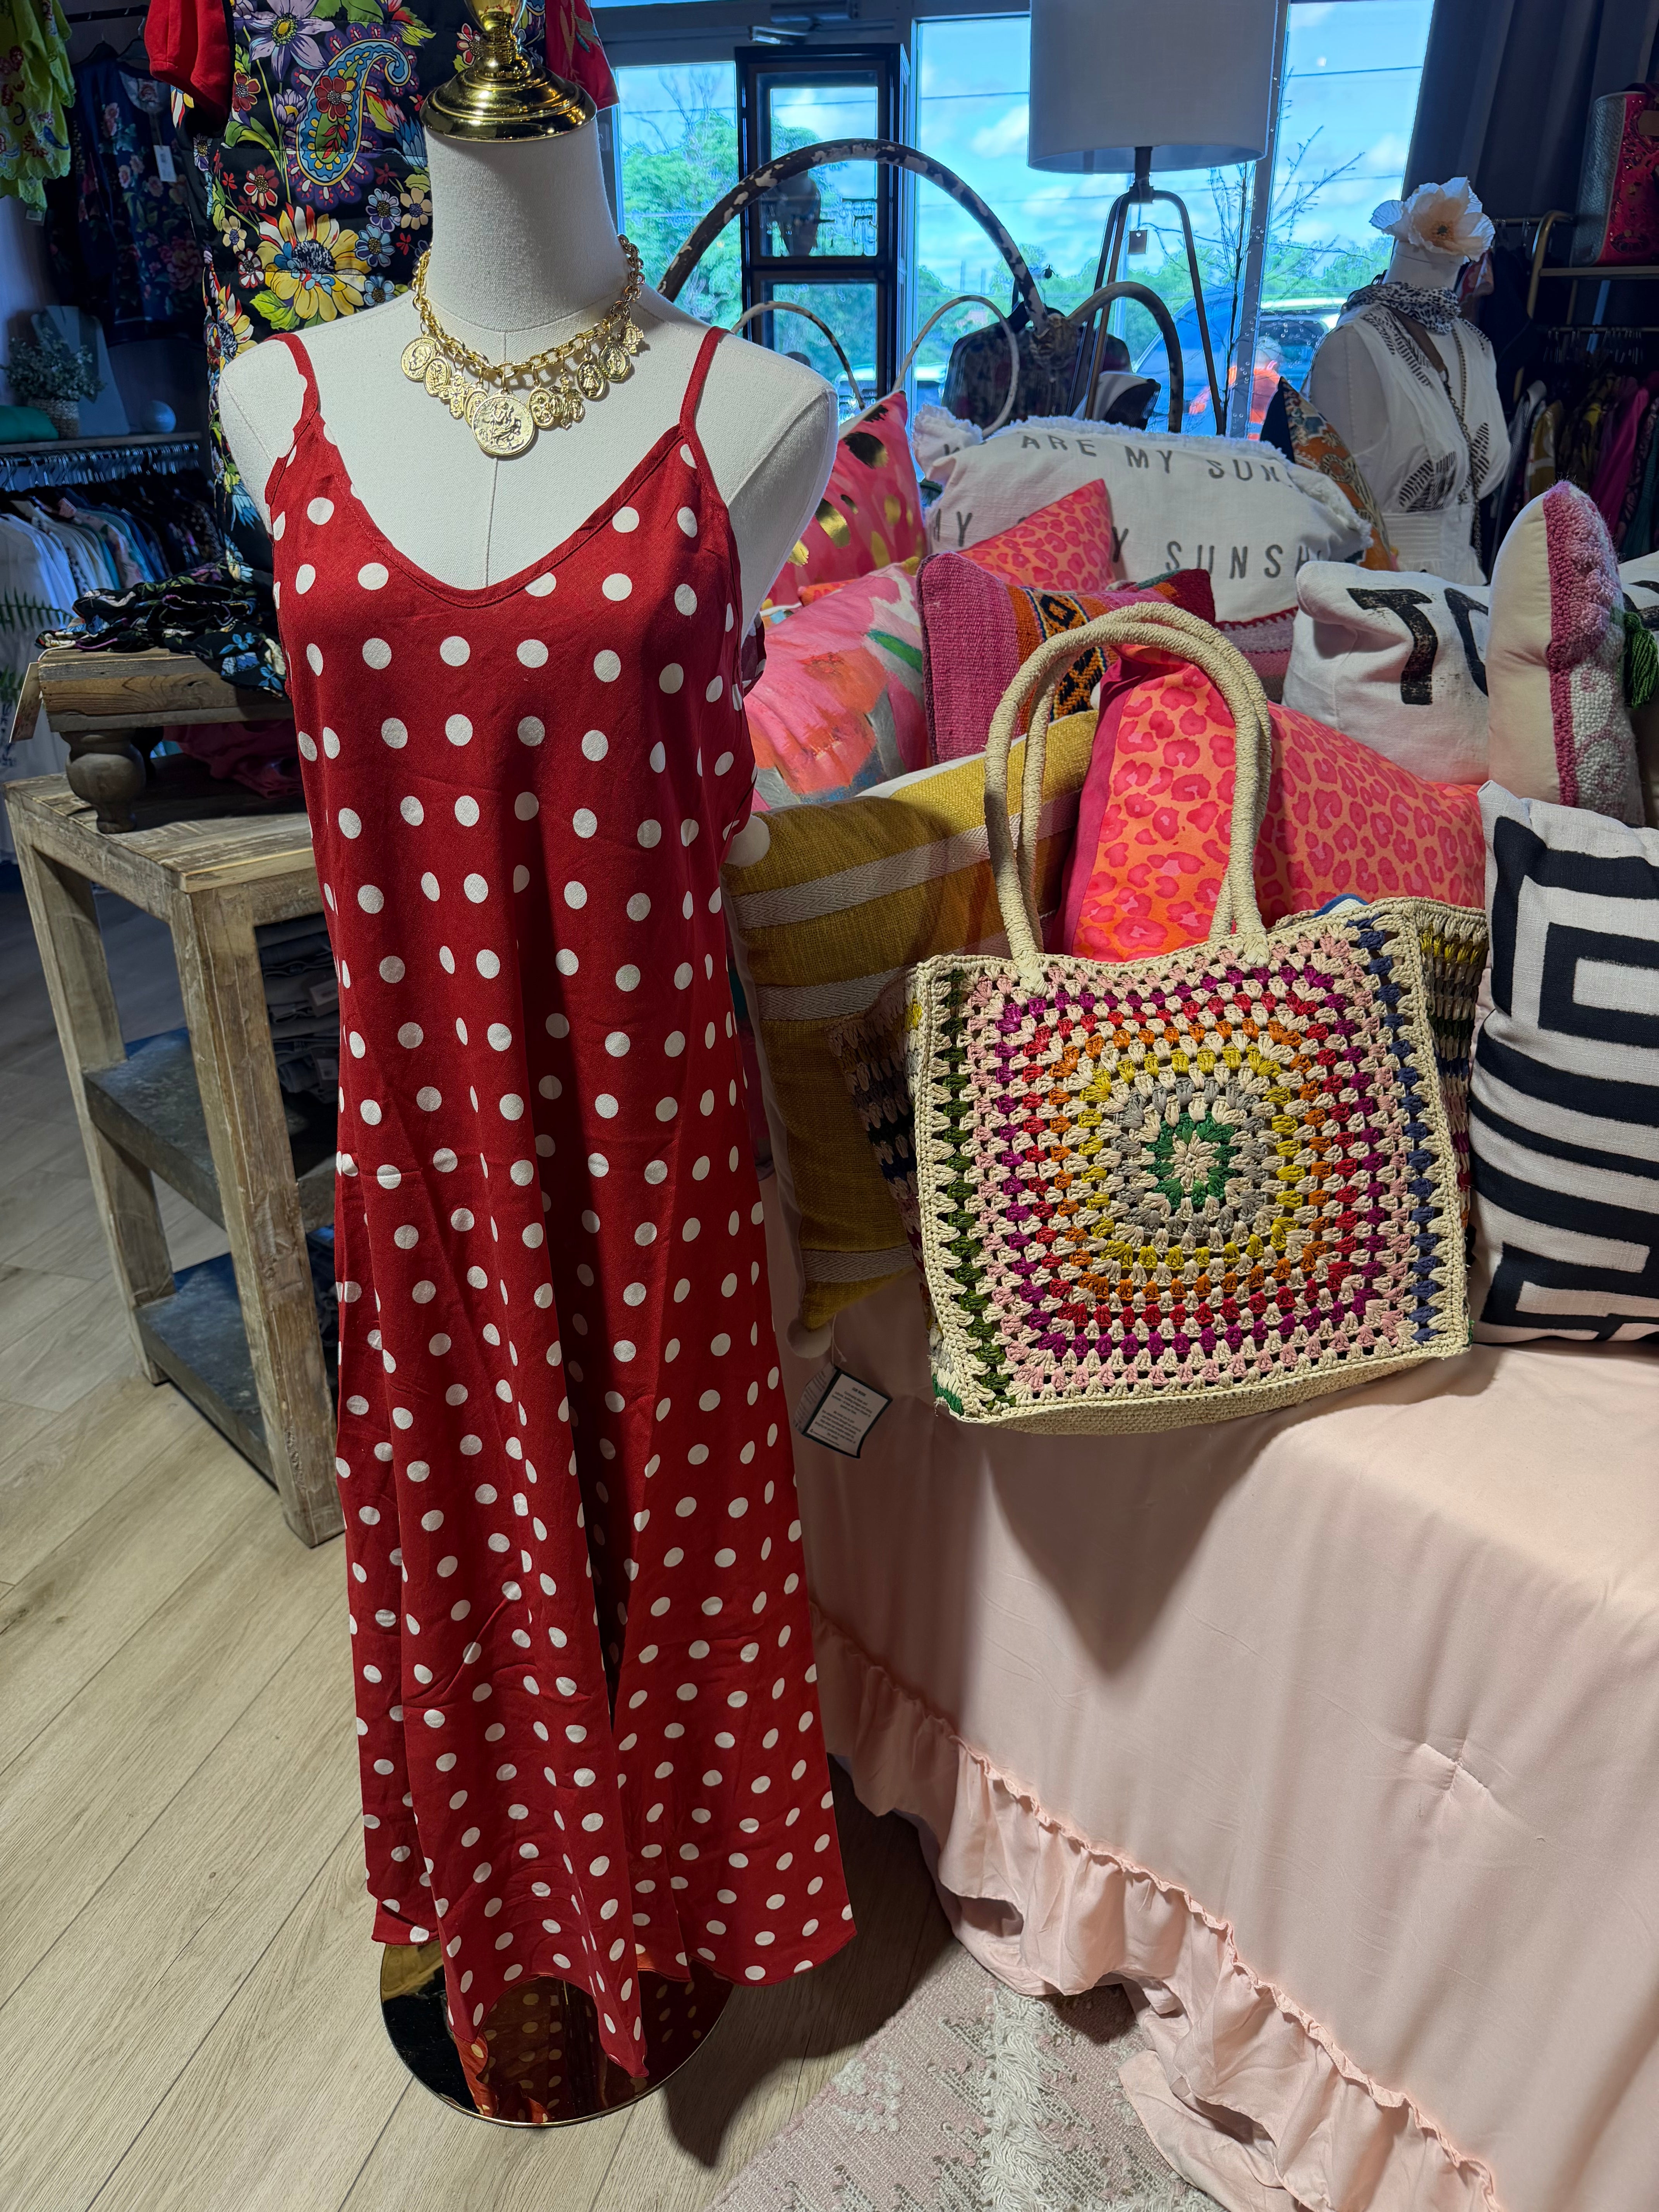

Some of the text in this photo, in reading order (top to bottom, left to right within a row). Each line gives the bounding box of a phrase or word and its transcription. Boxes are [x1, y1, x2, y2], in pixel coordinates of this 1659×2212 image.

[1021, 434, 1292, 488] ARE MY SUN
